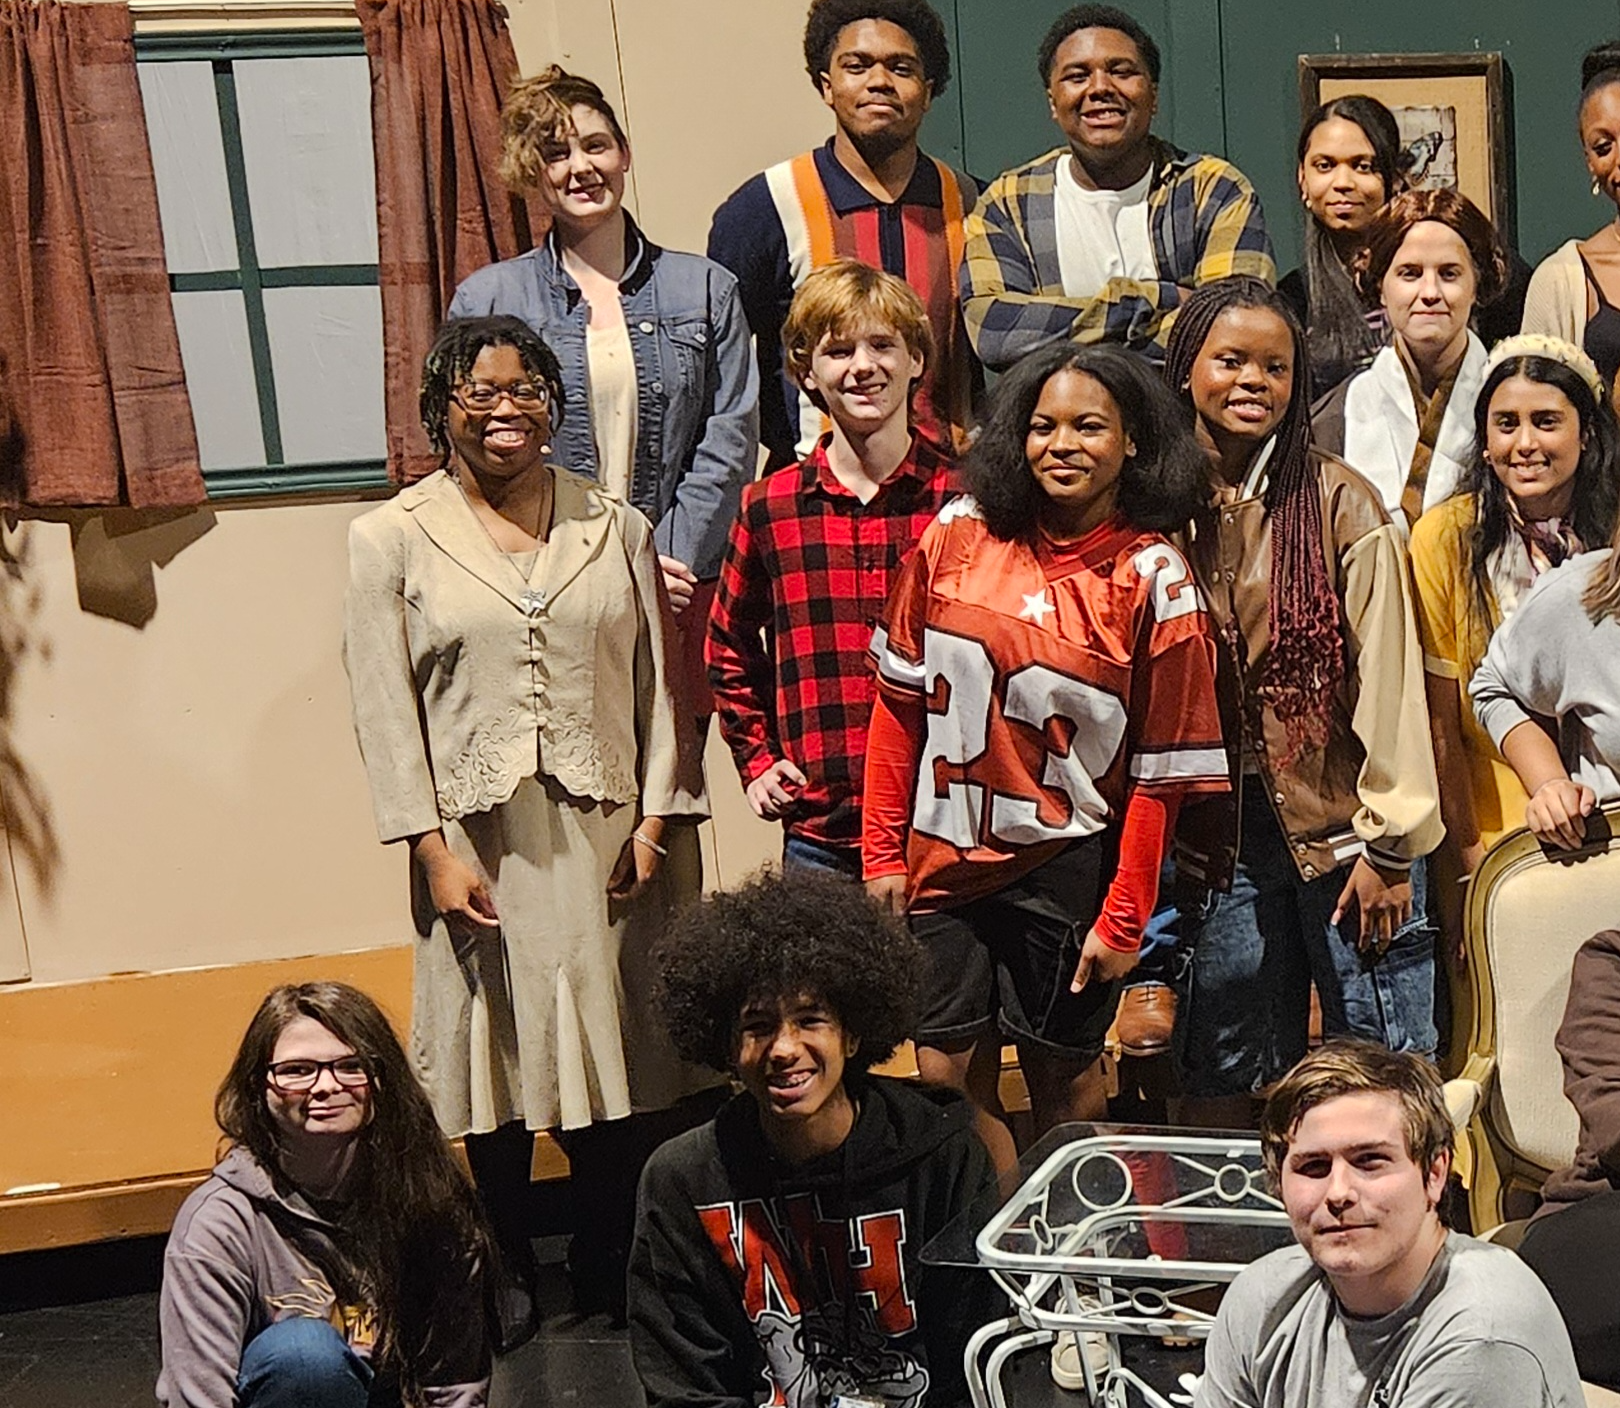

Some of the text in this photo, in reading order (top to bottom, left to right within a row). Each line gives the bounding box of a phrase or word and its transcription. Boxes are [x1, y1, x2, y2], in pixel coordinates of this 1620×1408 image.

[1133, 543, 1207, 624] 2
[913, 628, 1128, 848] 23
[694, 1192, 917, 1337] WH
